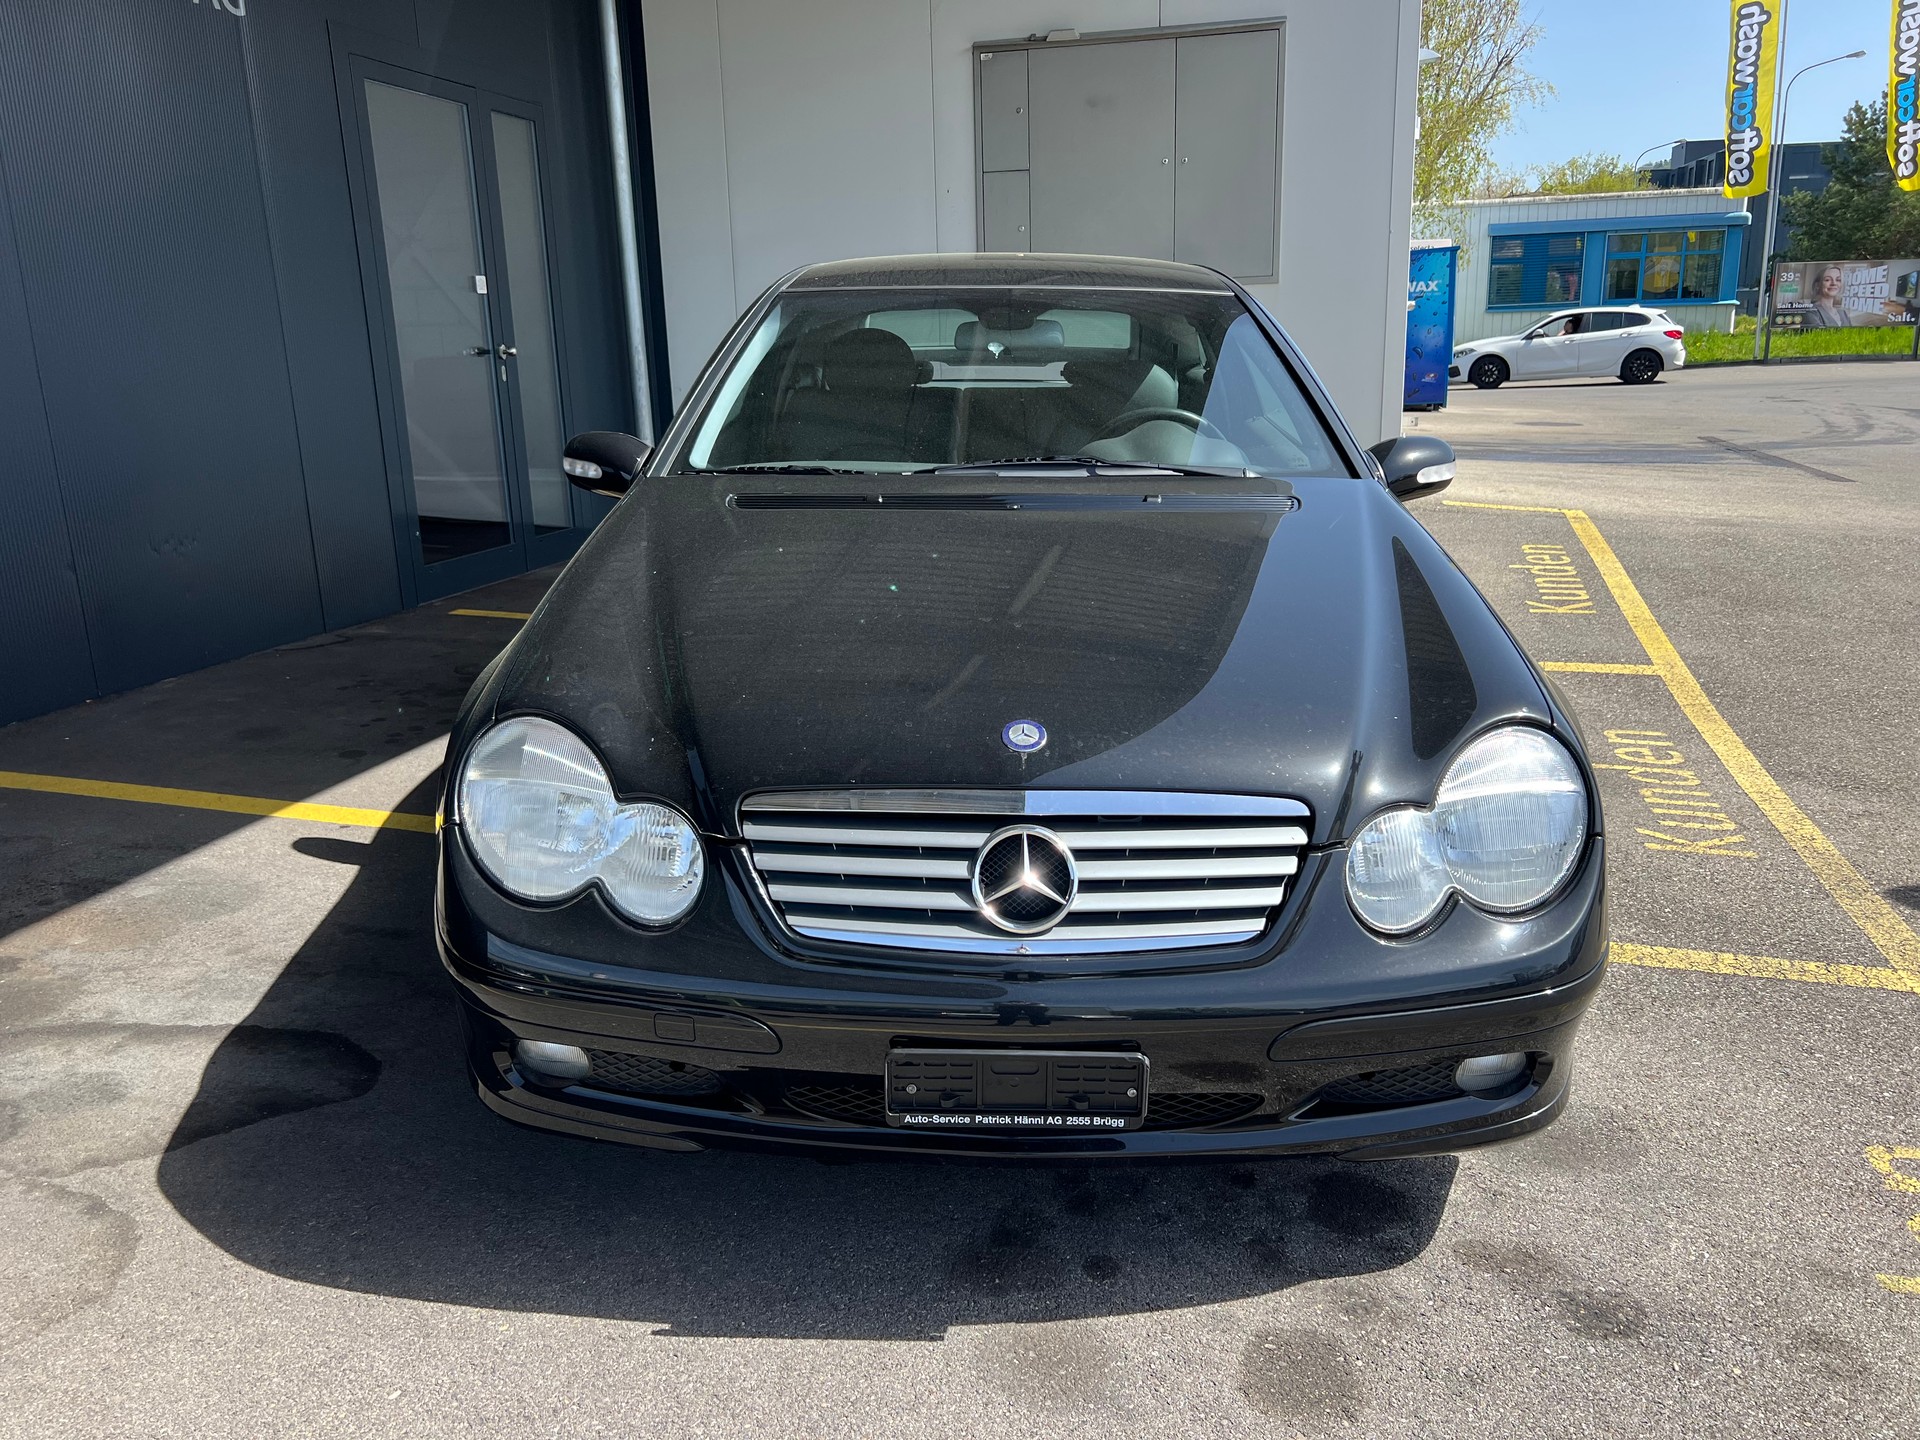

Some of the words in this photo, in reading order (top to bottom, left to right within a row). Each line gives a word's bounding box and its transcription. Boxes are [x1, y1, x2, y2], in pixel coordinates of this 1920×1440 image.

[1843, 265, 1888, 286] HOME
[1843, 283, 1890, 298] SPEED
[1842, 297, 1885, 315] HOME
[1887, 312, 1916, 322] Salt.
[1509, 544, 1597, 614] Kunden
[1592, 729, 1760, 859] Kunden
[904, 1114, 971, 1124] Auto-Service
[975, 1115, 1012, 1124] Patrick
[1014, 1116, 1044, 1125] Hänni
[1046, 1116, 1063, 1125] AG
[1066, 1116, 1091, 1126] 2555
[1093, 1117, 1125, 1128] Brügg
